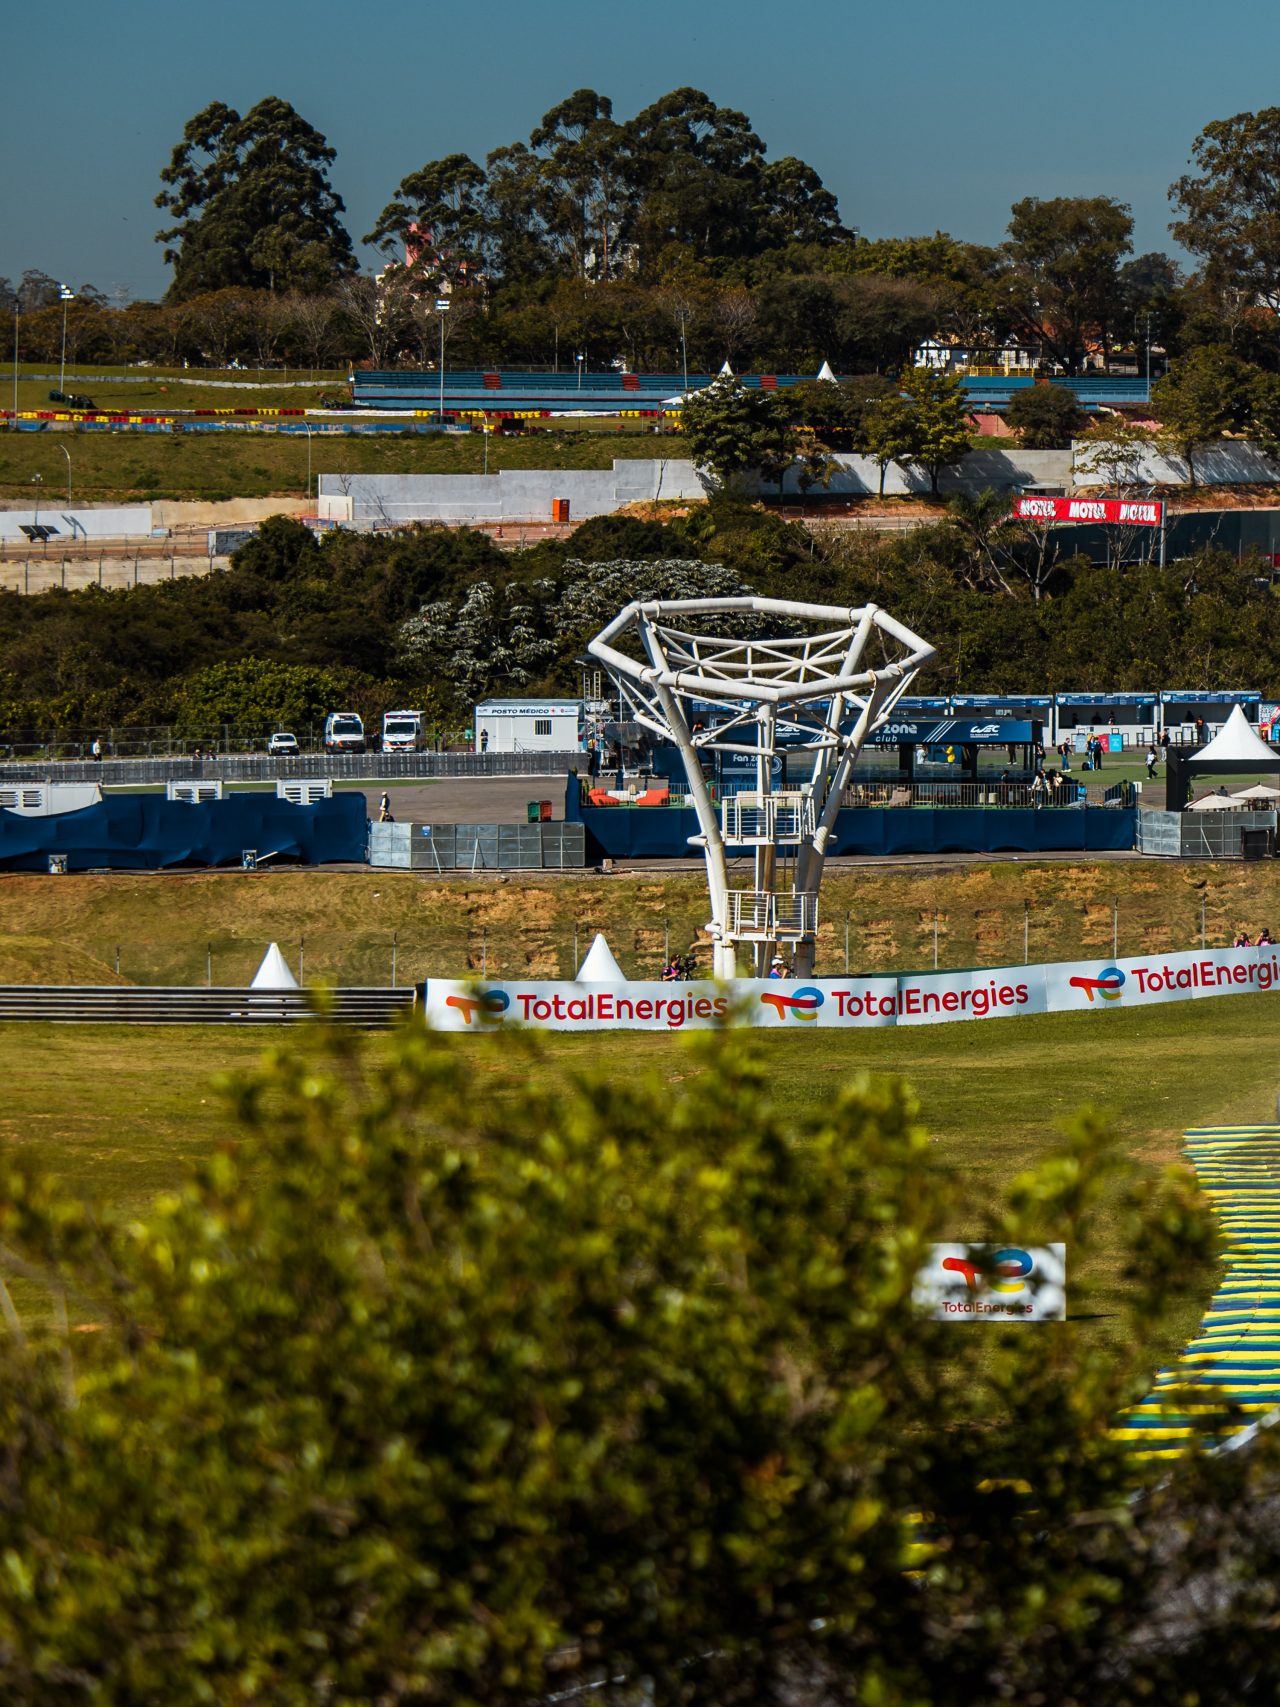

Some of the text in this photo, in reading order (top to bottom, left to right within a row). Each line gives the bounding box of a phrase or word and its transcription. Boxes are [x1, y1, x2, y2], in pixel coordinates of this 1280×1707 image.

[1019, 499, 1157, 522] MOTUL MOTUL MOTUL
[883, 723, 917, 734] zone
[733, 754, 749, 762] fan
[517, 992, 728, 1028] TotalEnergies
[831, 981, 1029, 1017] TotalEnergies
